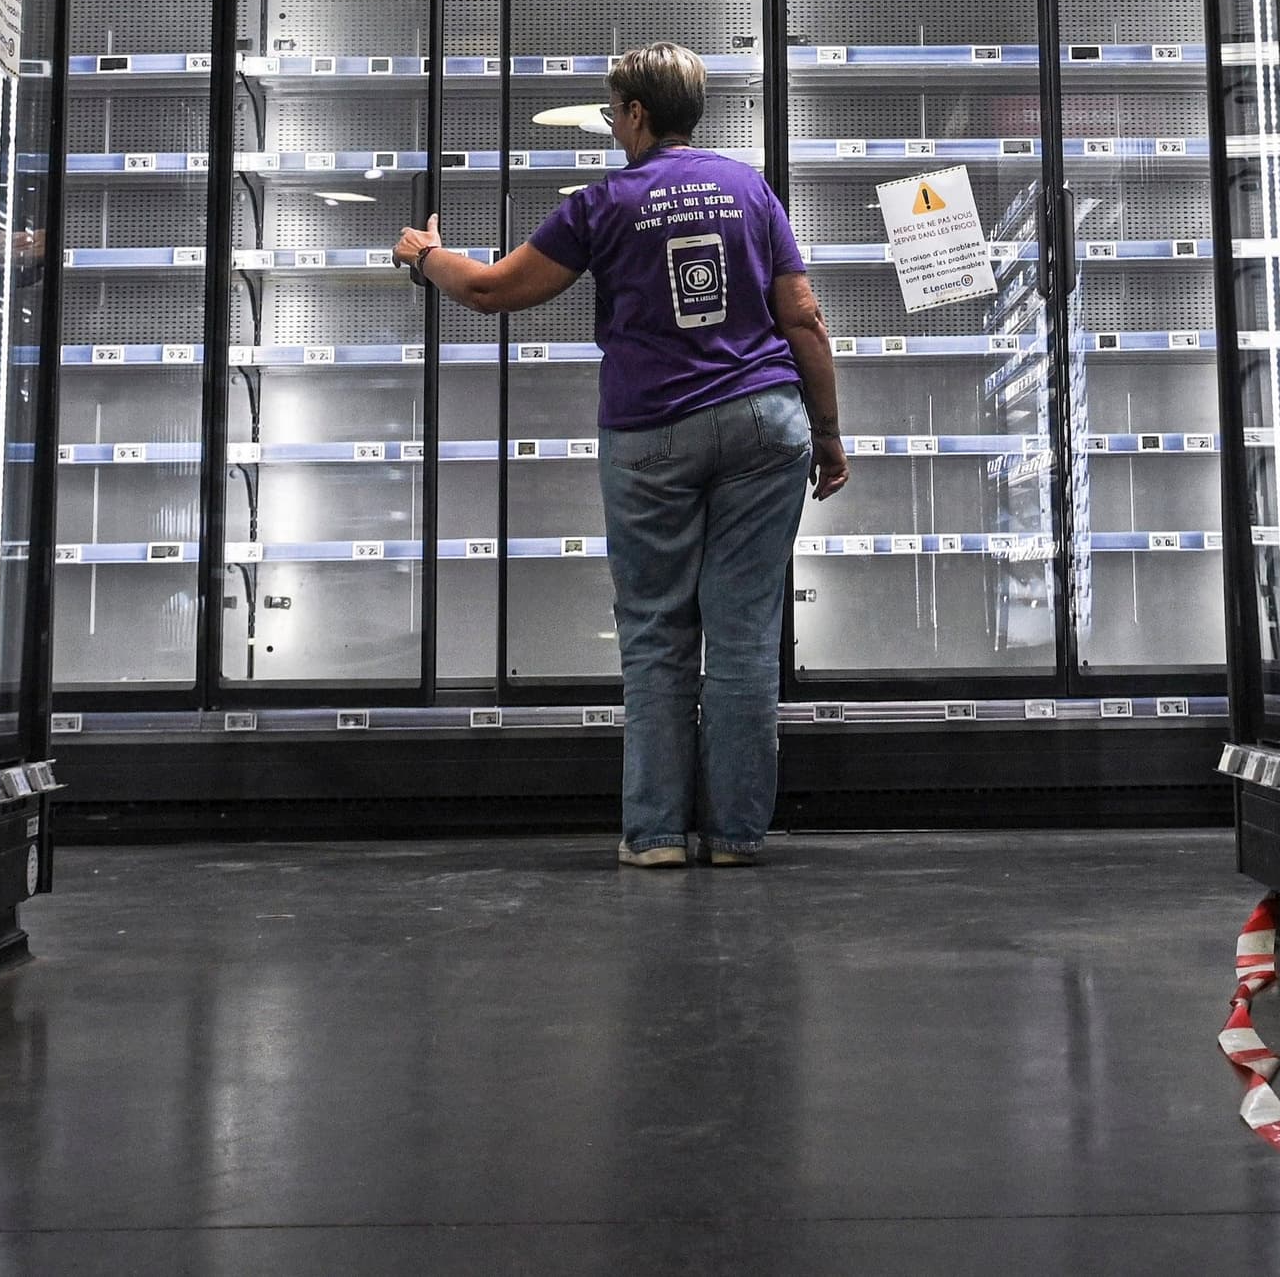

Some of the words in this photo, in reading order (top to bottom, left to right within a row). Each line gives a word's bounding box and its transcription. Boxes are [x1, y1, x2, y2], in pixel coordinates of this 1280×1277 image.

[649, 189, 667, 199] MON
[671, 182, 721, 195] E.LECLERC,
[640, 200, 679, 215] L'APPLI
[683, 197, 700, 206] QUI
[704, 195, 735, 205] DÉFEND
[634, 217, 663, 232] VOTRE
[667, 210, 705, 225] POUVOIR
[708, 209, 744, 220] D'ACHAT
[892, 225, 916, 236] MERCI
[916, 222, 926, 230] DE
[926, 220, 937, 229] NE
[937, 216, 952, 226] PAS
[952, 211, 974, 222] VOUS
[893, 235, 917, 246] SERVIR
[918, 231, 937, 241] DANS
[937, 227, 950, 237] LES
[951, 220, 977, 233] FRIGOS
[900, 257, 909, 265] En
[910, 253, 932, 263] raison
[933, 248, 947, 258] d'un
[936, 258, 947, 267] les
[948, 252, 977, 265] produits
[905, 275, 920, 285] sont
[921, 272, 936, 282] pas
[936, 260, 986, 277] consommables
[922, 279, 962, 295] E.Leclerc
